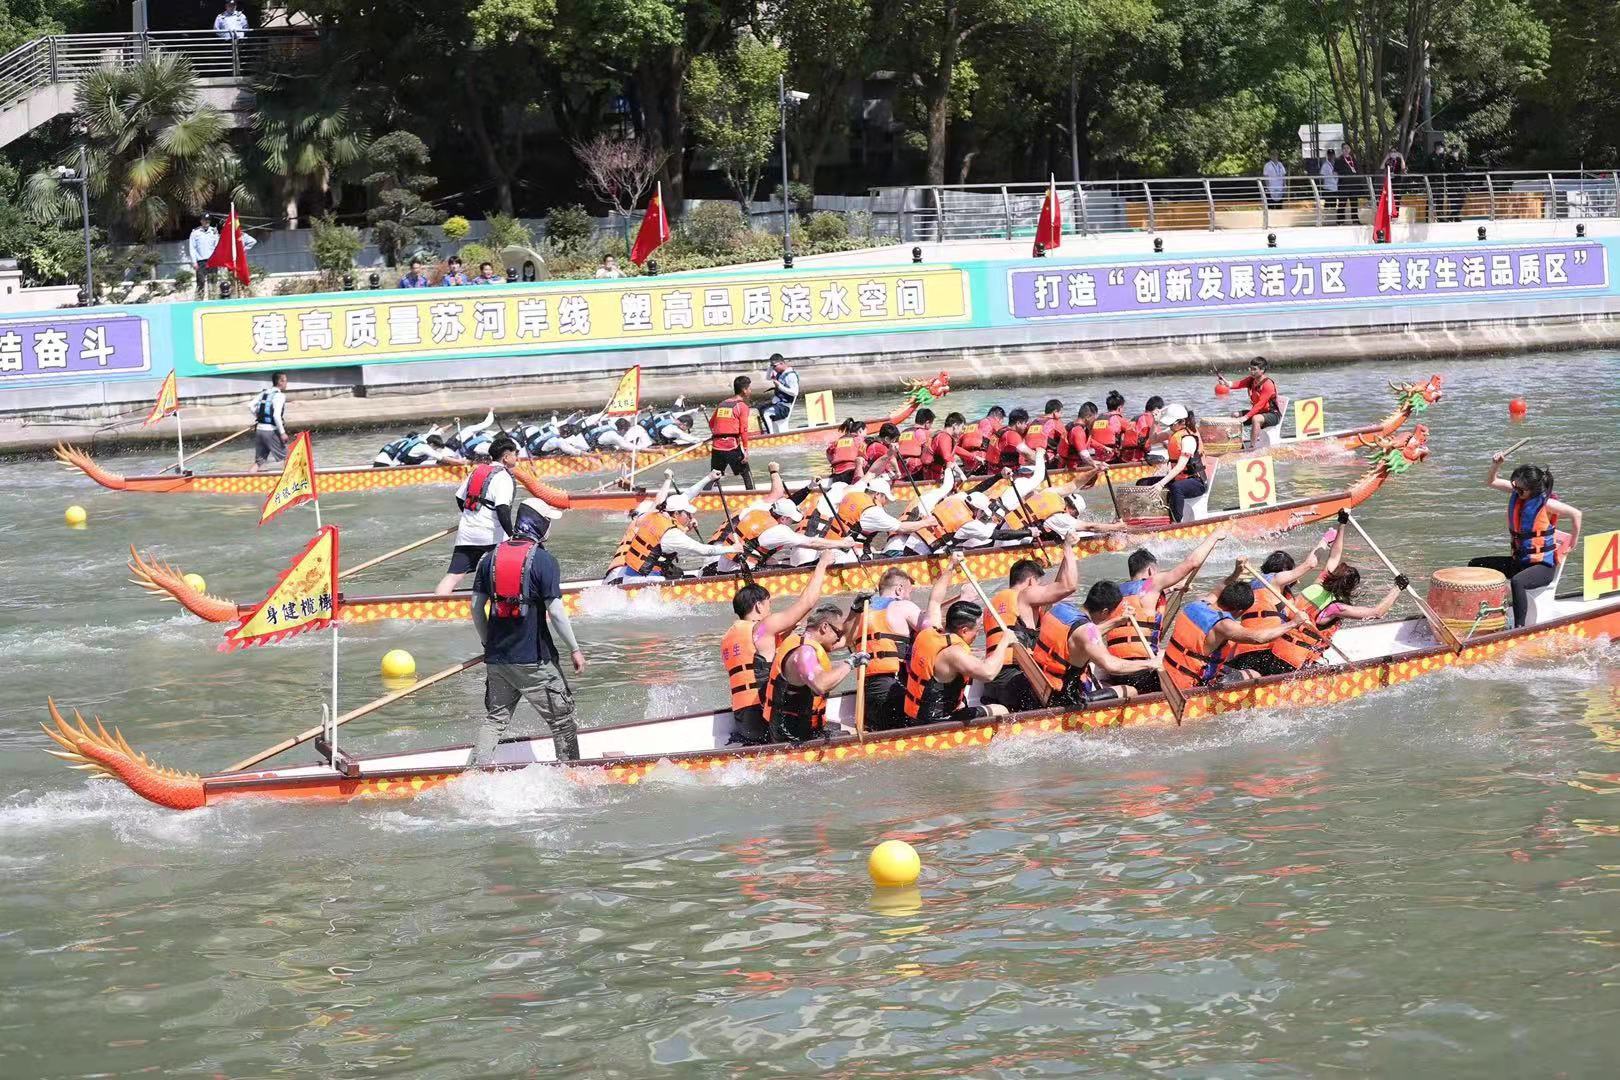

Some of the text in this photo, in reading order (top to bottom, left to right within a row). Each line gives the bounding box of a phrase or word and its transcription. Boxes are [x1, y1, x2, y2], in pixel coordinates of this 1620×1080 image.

[1034, 250, 1588, 310] 打造“创新发展活力区 美好生活品质区”
[252, 279, 925, 354] 建高质量苏河岸线 塑高品质滨水空间
[815, 393, 827, 421] 1
[1302, 401, 1319, 434] 2
[1246, 460, 1271, 502] 3
[1593, 533, 1620, 590] 4
